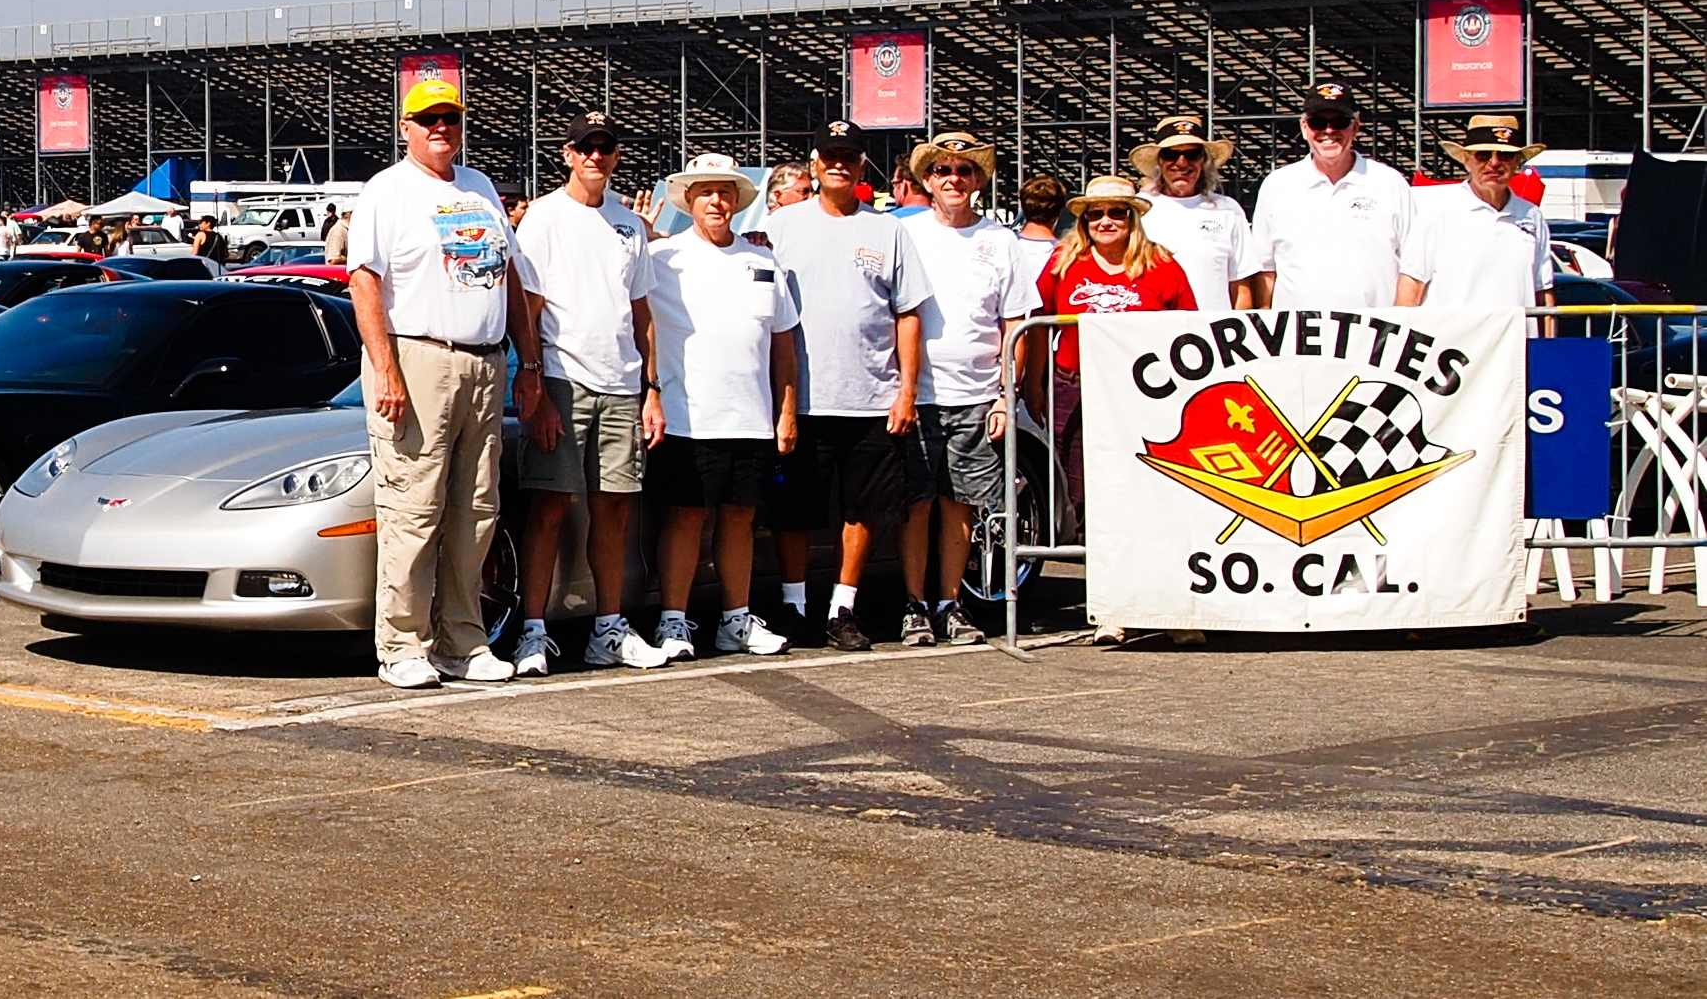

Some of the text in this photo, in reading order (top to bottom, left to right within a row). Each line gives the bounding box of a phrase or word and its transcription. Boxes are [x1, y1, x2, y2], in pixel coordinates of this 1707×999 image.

[1451, 61, 1493, 71] Insurance
[1133, 311, 1469, 399] CORVETTES
[1188, 552, 1418, 596] SO. CAL.
